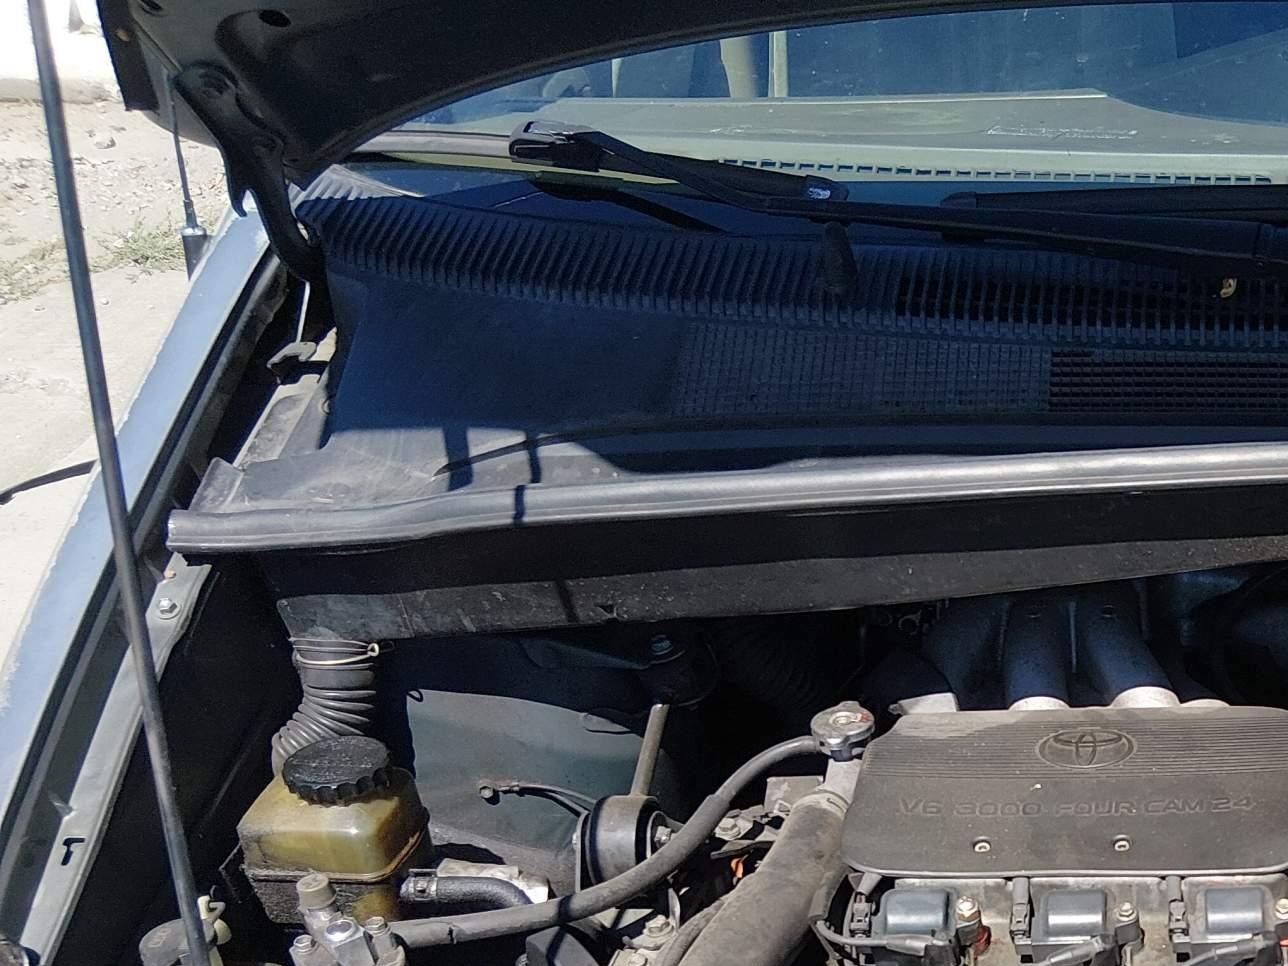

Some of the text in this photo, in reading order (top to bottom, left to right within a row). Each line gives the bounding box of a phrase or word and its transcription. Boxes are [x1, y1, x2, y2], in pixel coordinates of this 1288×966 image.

[899, 796, 1257, 817] V6 3000 FOUR CAM 24
